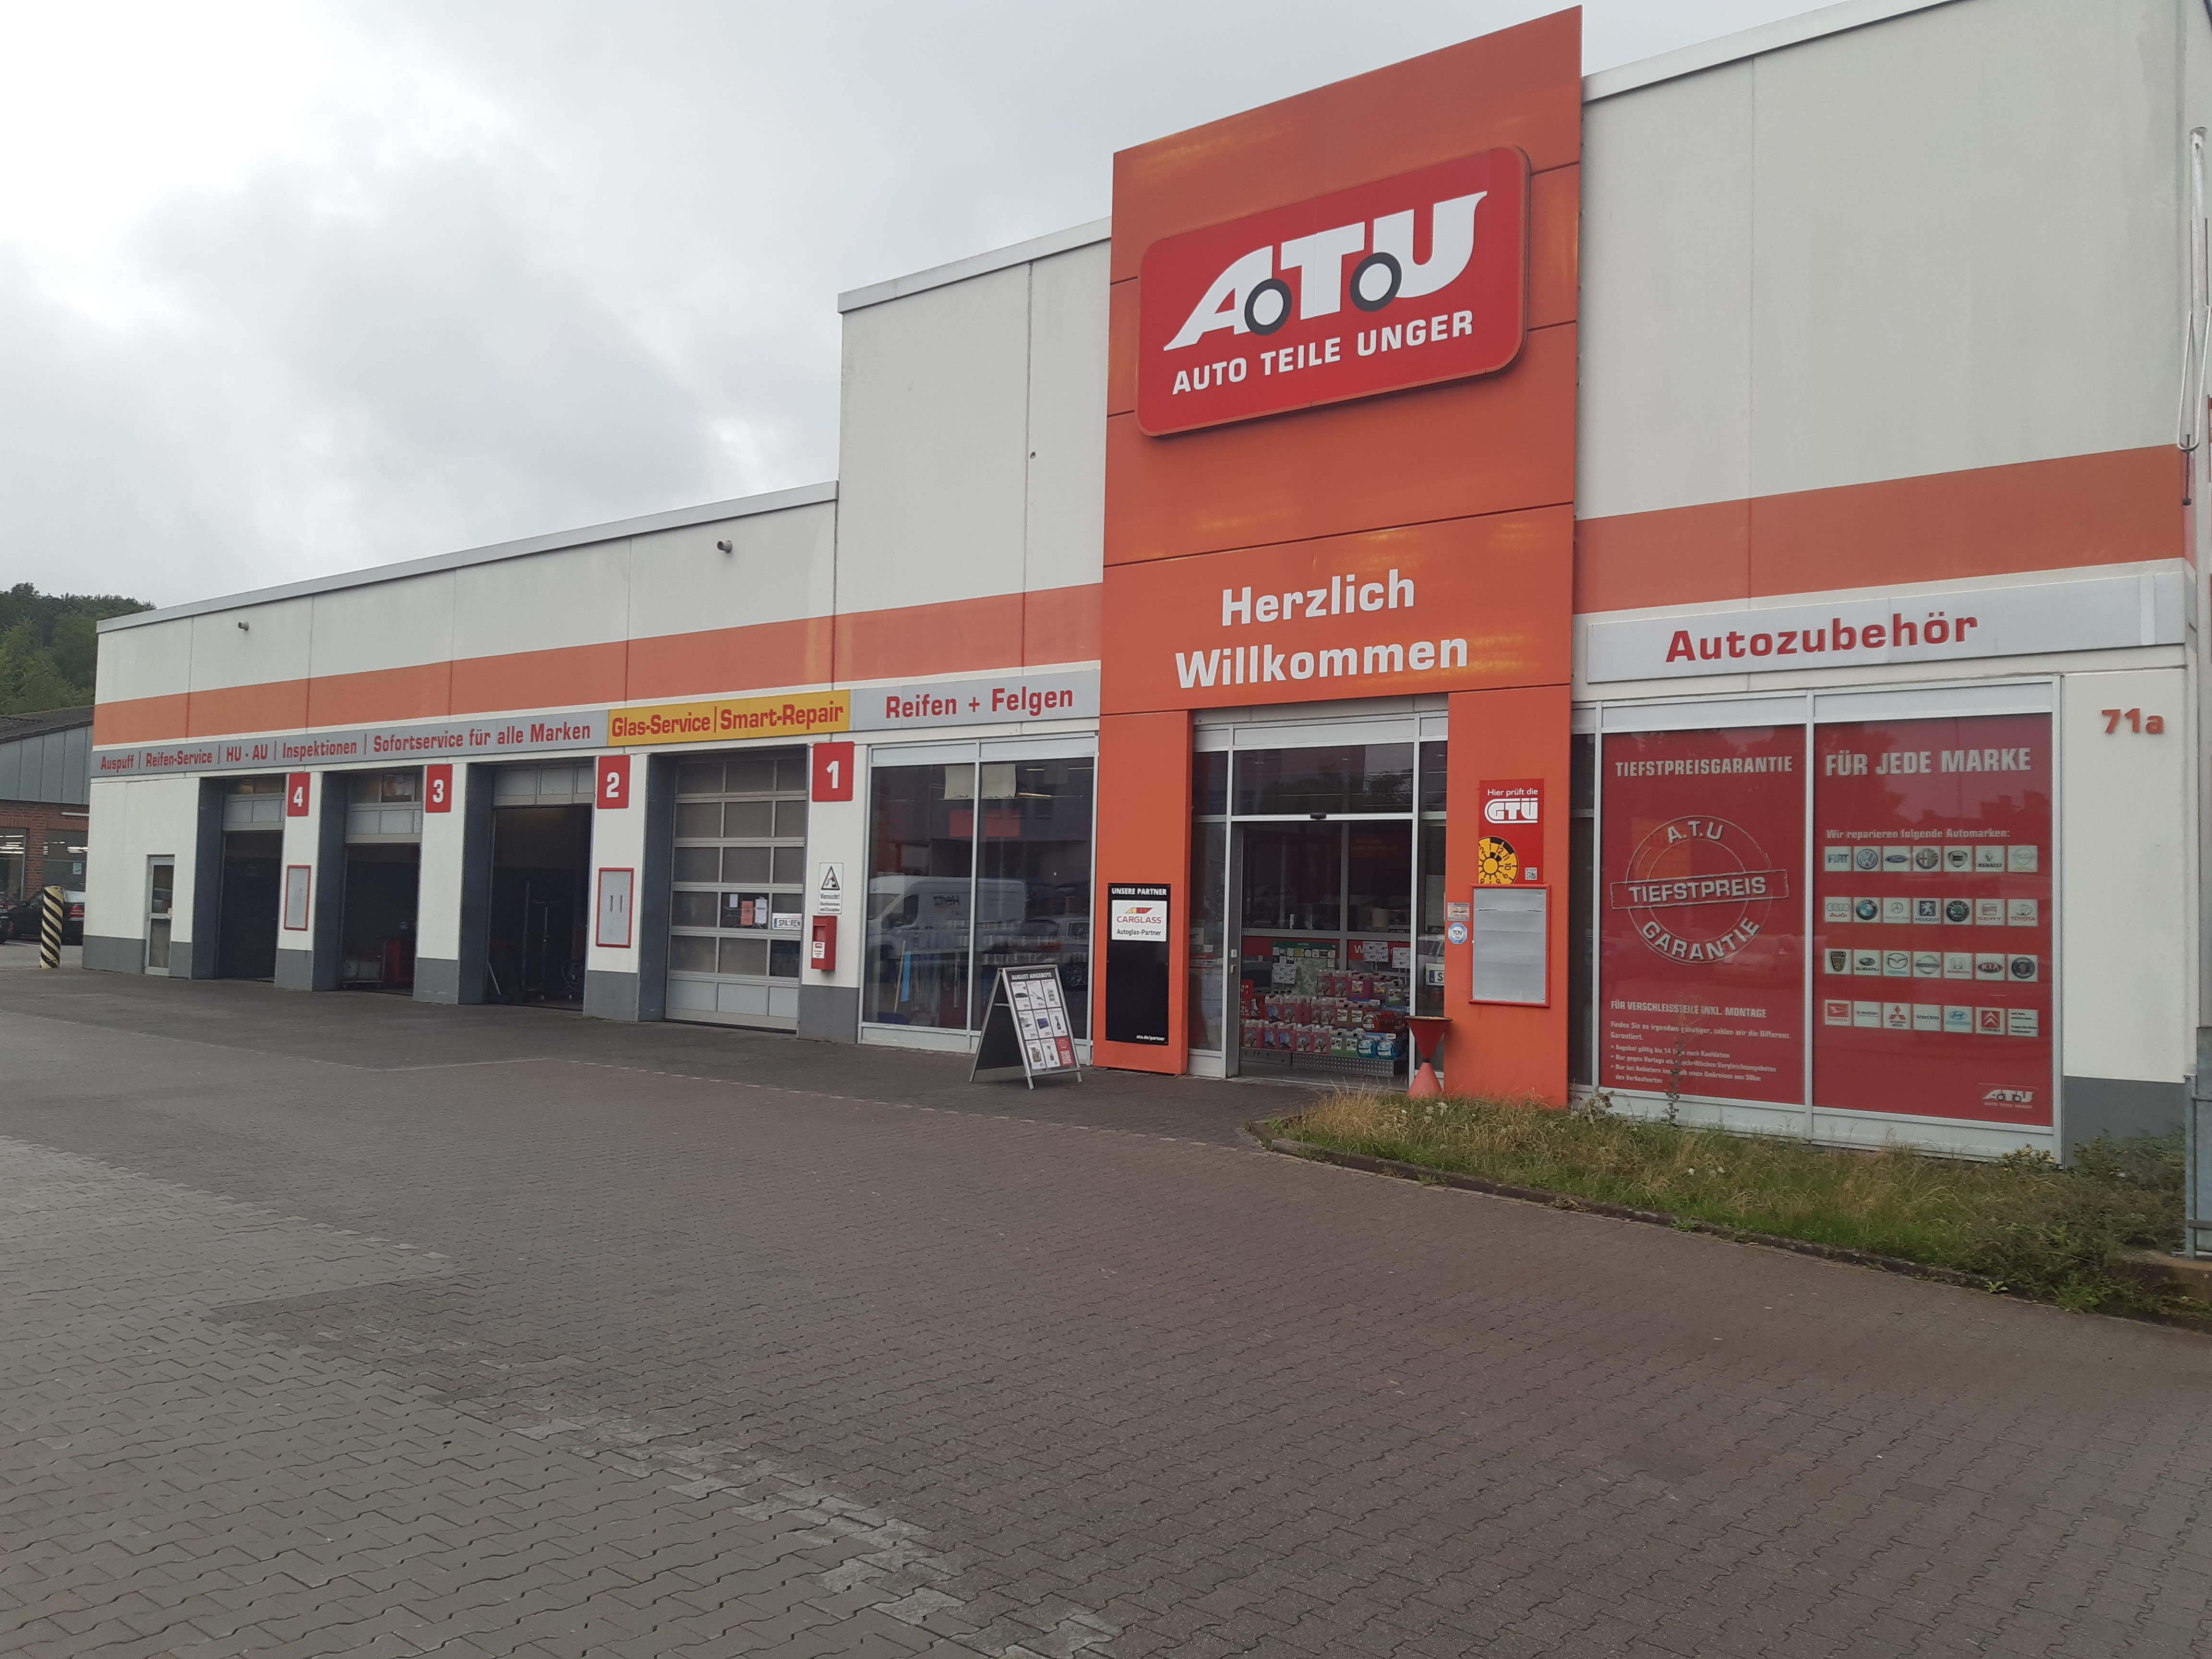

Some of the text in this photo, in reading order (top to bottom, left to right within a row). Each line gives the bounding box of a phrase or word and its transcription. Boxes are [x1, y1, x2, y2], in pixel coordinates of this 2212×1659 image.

[1172, 310, 1473, 395] AUTO TEILE UNGER
[1222, 569, 1415, 626] Herzlich
[1666, 611, 1978, 663] Autozubehör
[1175, 637, 1467, 688] Willkommen
[886, 686, 1074, 719] Reifen + Felgen
[612, 700, 844, 737] Glas-Service Smart-Repair
[2101, 708, 2164, 734] 71a
[101, 754, 134, 773] Auspuff
[146, 749, 212, 767] Reifen-Service
[226, 746, 241, 762] HU
[252, 745, 268, 760] AU
[283, 740, 357, 762] Inspektionen
[374, 730, 464, 753] Sofortservice
[469, 729, 491, 746] für
[498, 725, 524, 745] alle
[530, 721, 590, 743] Marken
[826, 760, 840, 789] 1
[1616, 756, 1793, 776] TIEFSTPREISGARANTIE
[1826, 748, 2031, 776] FÜR JEDE MARKE
[293, 786, 303, 808] 4
[433, 780, 444, 803] 3
[606, 772, 620, 798] 2
[1506, 788, 1525, 797] prüft
[1488, 798, 1538, 820] GTÜ
[1827, 829, 2010, 840] Wir reparieren folgende Automarken:
[1630, 877, 1766, 902] TIEFSTPREIS
[1643, 917, 1760, 960] GARANTIE
[1611, 1000, 1625, 1010] FÜR
[1725, 1007, 1767, 1018] MONTAGE
[1611, 1032, 1644, 1040] Garantiert.
[1760, 1030, 1791, 1039] Differenz.
